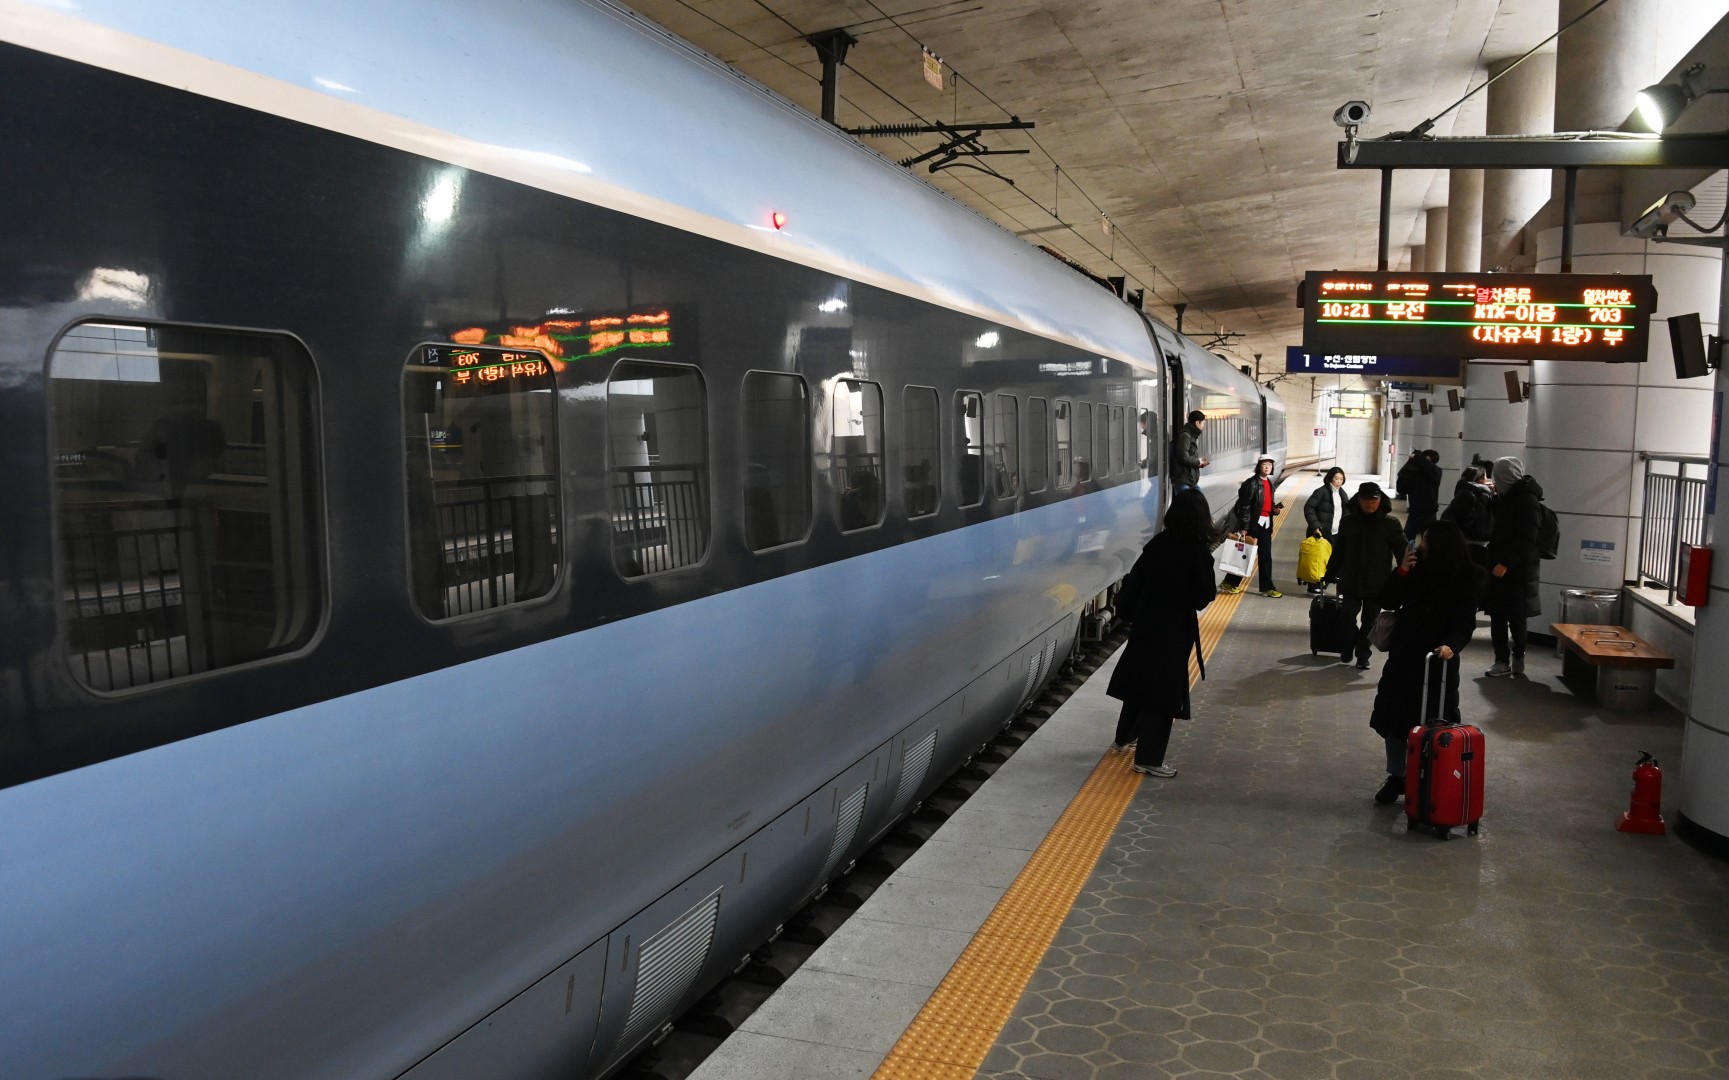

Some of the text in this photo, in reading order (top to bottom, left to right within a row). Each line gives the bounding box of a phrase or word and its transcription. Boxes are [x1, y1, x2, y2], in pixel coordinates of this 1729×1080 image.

[1475, 287, 1531, 303] 열차종류
[1583, 289, 1632, 305] 열차번호
[1322, 302, 1371, 318] 10:21
[1385, 301, 1426, 320] 부전
[1588, 307, 1622, 323] 703
[1472, 325, 1624, 346] (자유석 1량) 부
[1303, 354, 1310, 367] 1
